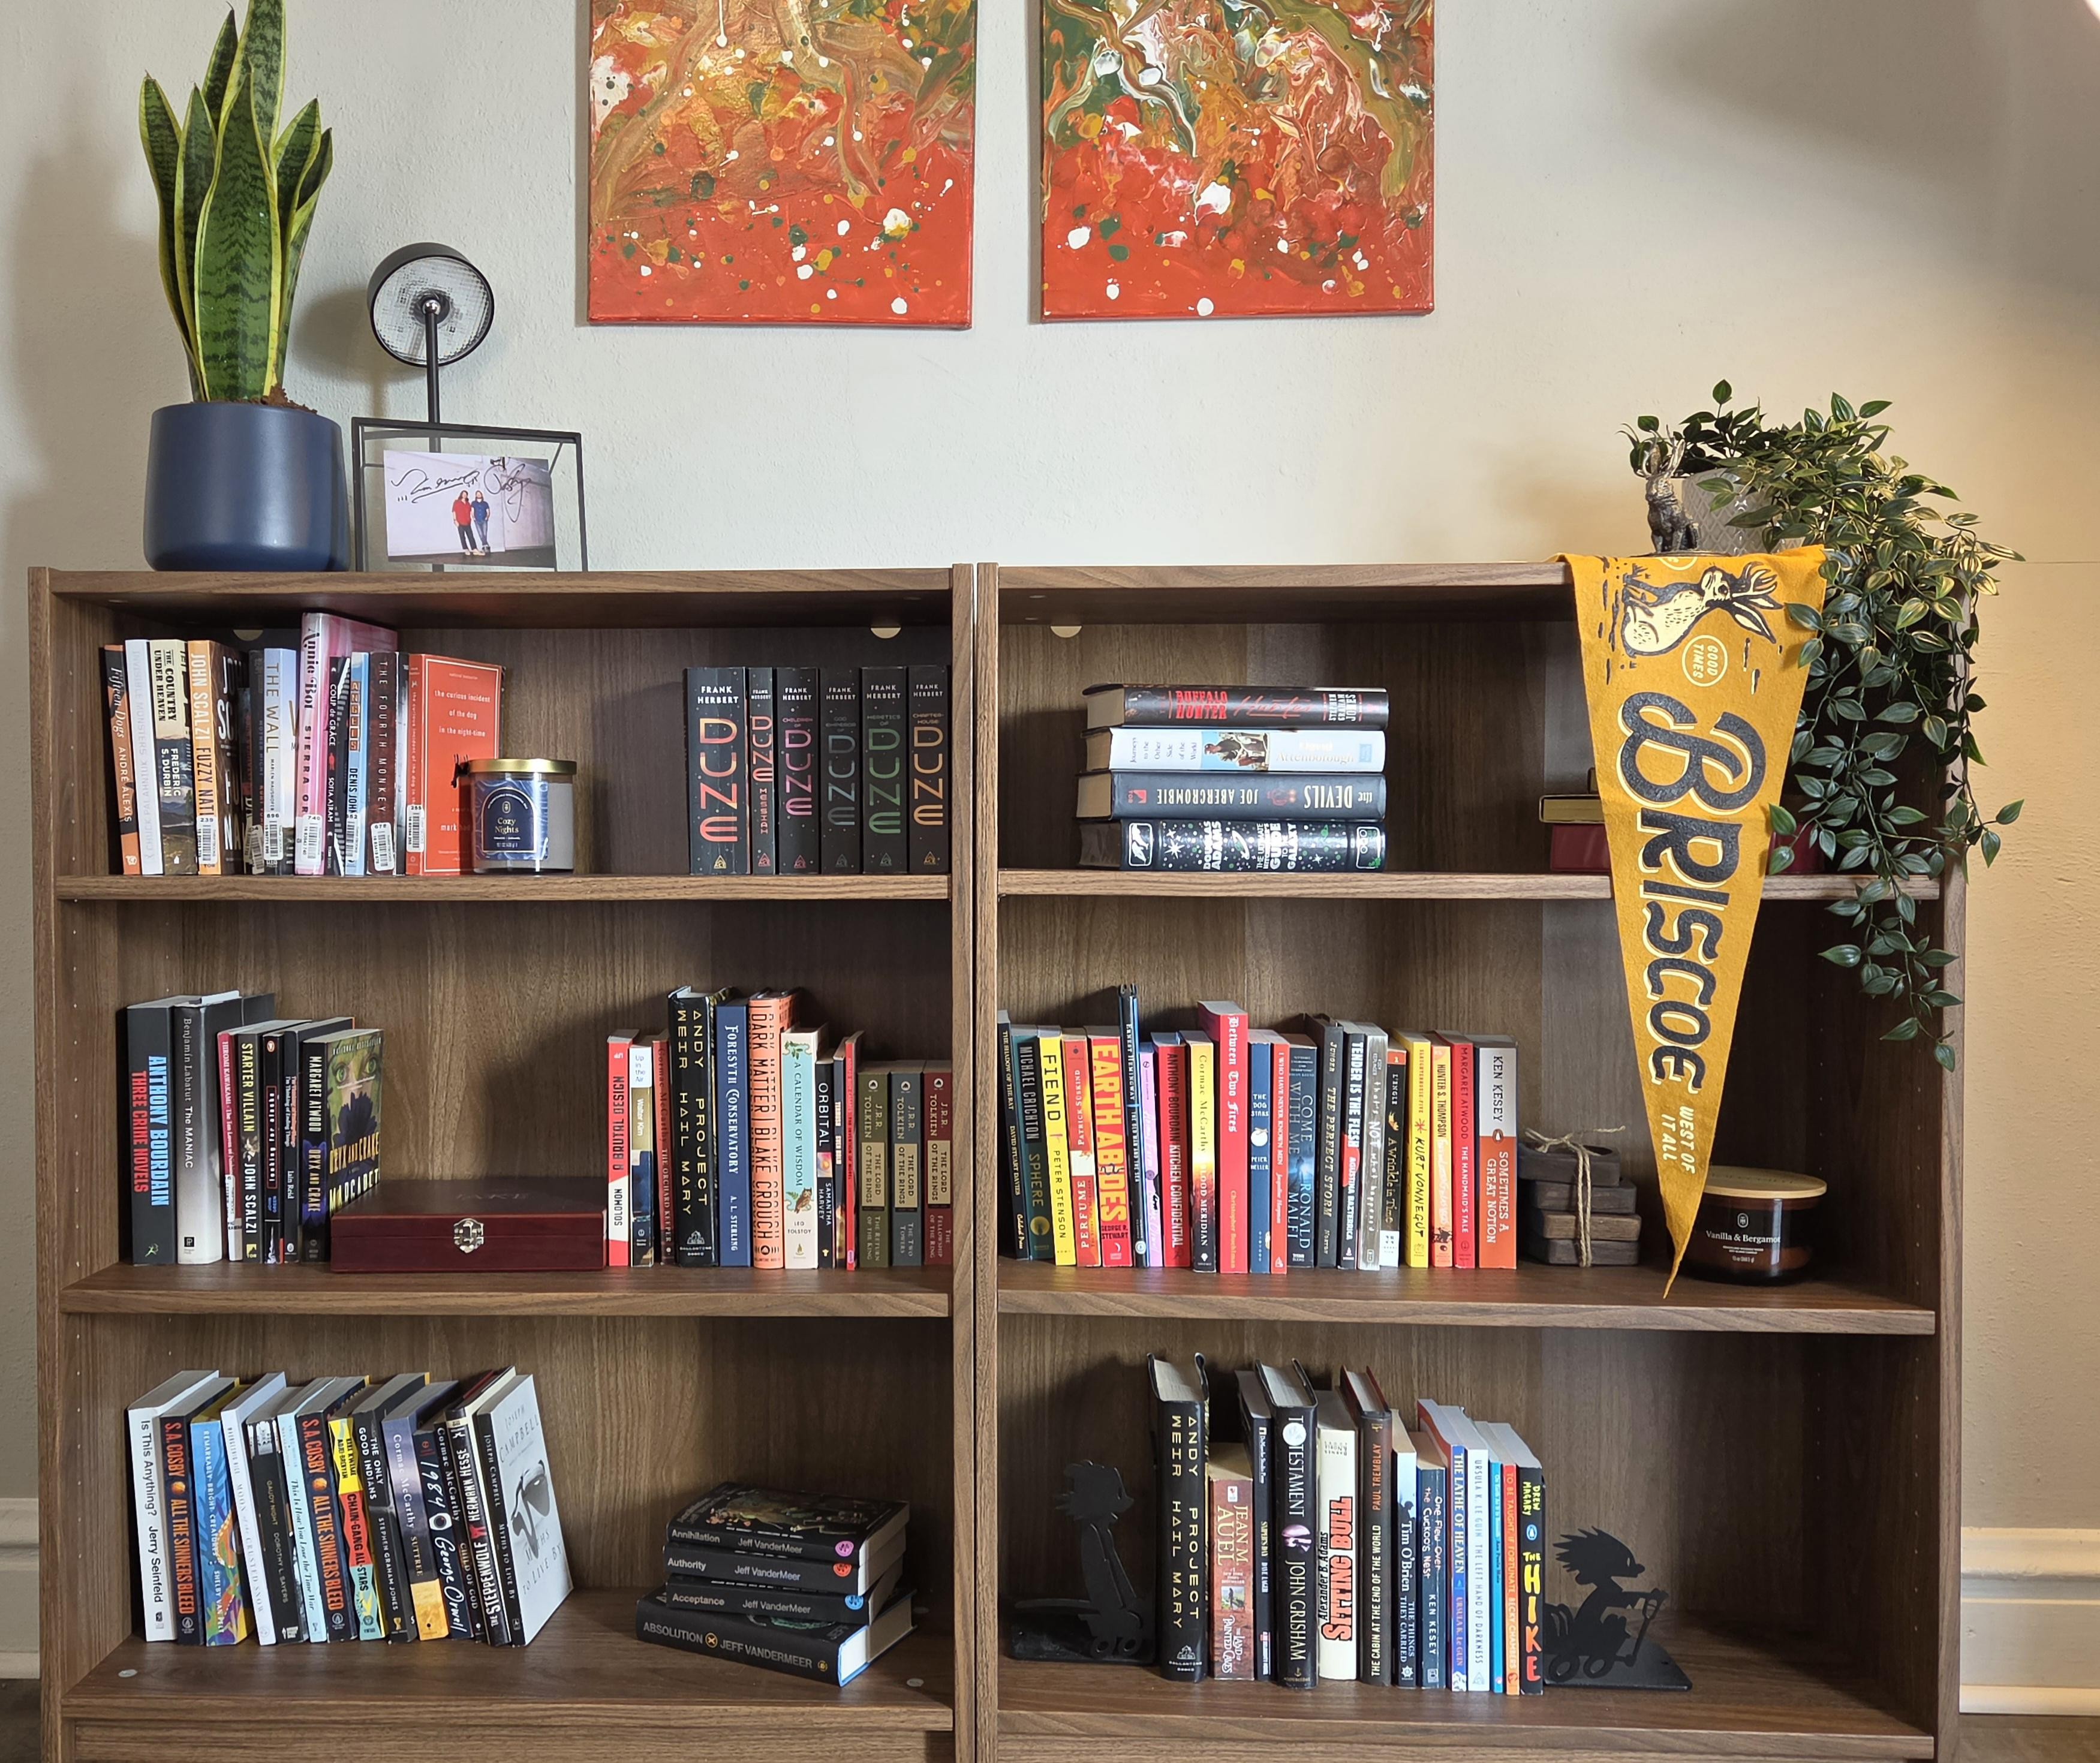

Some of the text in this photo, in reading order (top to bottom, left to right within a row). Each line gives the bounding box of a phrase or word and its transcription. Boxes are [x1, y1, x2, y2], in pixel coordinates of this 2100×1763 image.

[154, 650, 164, 682] UNDER
[166, 668, 177, 721] COUNTRY
[1693, 645, 1704, 679] TIMES
[1705, 645, 1719, 676] GOOD
[191, 654, 209, 740] JOHN SCALZI
[267, 662, 279, 753] THE WALL
[350, 681, 360, 750] ANGELS
[379, 696, 387, 750] FOURTH
[435, 690, 491, 705] the curious incident
[449, 709, 477, 721] of the dog
[697, 696, 738, 705] HERBERT
[1175, 704, 1227, 720] HUNTER
[1176, 691, 1227, 704] BUFFALO
[439, 725, 486, 738] in the night-time
[752, 715, 773, 783] DUNE
[197, 747, 214, 816] FUZZY NATI
[377, 759, 387, 813] MONKEY
[699, 718, 738, 842] DUNE
[785, 729, 812, 816] DUNE
[828, 735, 855, 826] DUNE
[869, 728, 901, 834] DUNE
[913, 726, 943, 826] DUNE
[1157, 788, 1258, 805] JOE ABERCROMBIE
[1303, 785, 1353, 809] DEVILS
[496, 826, 519, 838] Nights
[498, 817, 516, 830] Cozy
[1203, 821, 1212, 870] DOUGLAS
[1212, 821, 1222, 870] ADAMS
[1617, 692, 1766, 1094] BRISCOE
[677, 1010, 688, 1069] WEIR
[693, 1010, 704, 1068] ANDY
[752, 1013, 769, 1115] DARK MATTER
[242, 1043, 254, 1132] STARTER VILLAIN
[308, 1056, 322, 1132] MARGARET ATWOOD
[1020, 1046, 1039, 1140] MICHAEL CRICHTON
[1043, 1055, 1061, 1121] FIEND
[1227, 1017, 1238, 1133] Between Two Fires
[1493, 1055, 1503, 1123] KEN KESEY
[131, 1070, 149, 1193] THREE CRIME NOVELS
[149, 1056, 169, 1206] ANTHONY BOURDAIN
[726, 1088, 739, 1174] CONSERVATORY
[795, 1132, 802, 1143] OF
[817, 1082, 829, 1147] ORBITAL
[1093, 1044, 1128, 1222] EARTH ABIDES
[1288, 1081, 1301, 1154] WITH ME
[1301, 1094, 1313, 1142] COME
[1662, 1114, 1677, 1161] IT ALL
[1679, 1106, 1695, 1174] WEST OF
[679, 1092, 691, 1215] HAIL MARY
[695, 1097, 707, 1206] PROJECT
[754, 1127, 772, 1239] BLAKE CROUCH
[1029, 1153, 1043, 1207] SPHERE
[1323, 1087, 1336, 1217] THE PERFECT STORM
[245, 1163, 257, 1234] JOHN SCALZI
[614, 1189, 622, 1226] SOLOMON
[1054, 1150, 1066, 1239] PETER STENSON
[1077, 1180, 1089, 1248] PERFUME
[1169, 1144, 1184, 1248] KITCHEN CONFIDENTIAL
[1287, 1192, 1298, 1239] MALFI
[1299, 1183, 1311, 1249] RONALD
[1413, 1136, 1425, 1238] KURT VONNEGUT
[1486, 1161, 1496, 1244] GREAT NOTION
[1499, 1151, 1508, 1233] SOMETIMES A
[1705, 1230, 1781, 1245] Vanilla & Bergamot
[141, 1420, 157, 1517] Is This Anything?
[359, 1427, 377, 1500] GOOD INDIANS
[370, 1437, 384, 1485] THE ONLY
[419, 1461, 446, 1508] 1984
[1372, 1443, 1381, 1511] PAUL TREMBLAY
[347, 1493, 363, 1552] CHAIN-GANG
[1523, 1481, 1533, 1516] MAGARY
[148, 1526, 163, 1603] Jerry Seinfeld
[354, 1553, 368, 1591] ALL-STARS
[378, 1517, 398, 1611] STEPHEN GRAHAM JONES
[667, 1557, 801, 1583] Authority Jeff VanderMeer
[672, 1529, 803, 1556] Annihilation Jeff VanderMeer
[1321, 1497, 1352, 1641] SITTING BULL
[1522, 1551, 1541, 1562] THE
[434, 1536, 467, 1633] George Orwell
[1285, 1560, 1305, 1660] JOHN GRISHAM
[643, 1621, 813, 1669] ABSOLUTION JEFF VANDERMEER
[1524, 1563, 1542, 1681] HIKE
